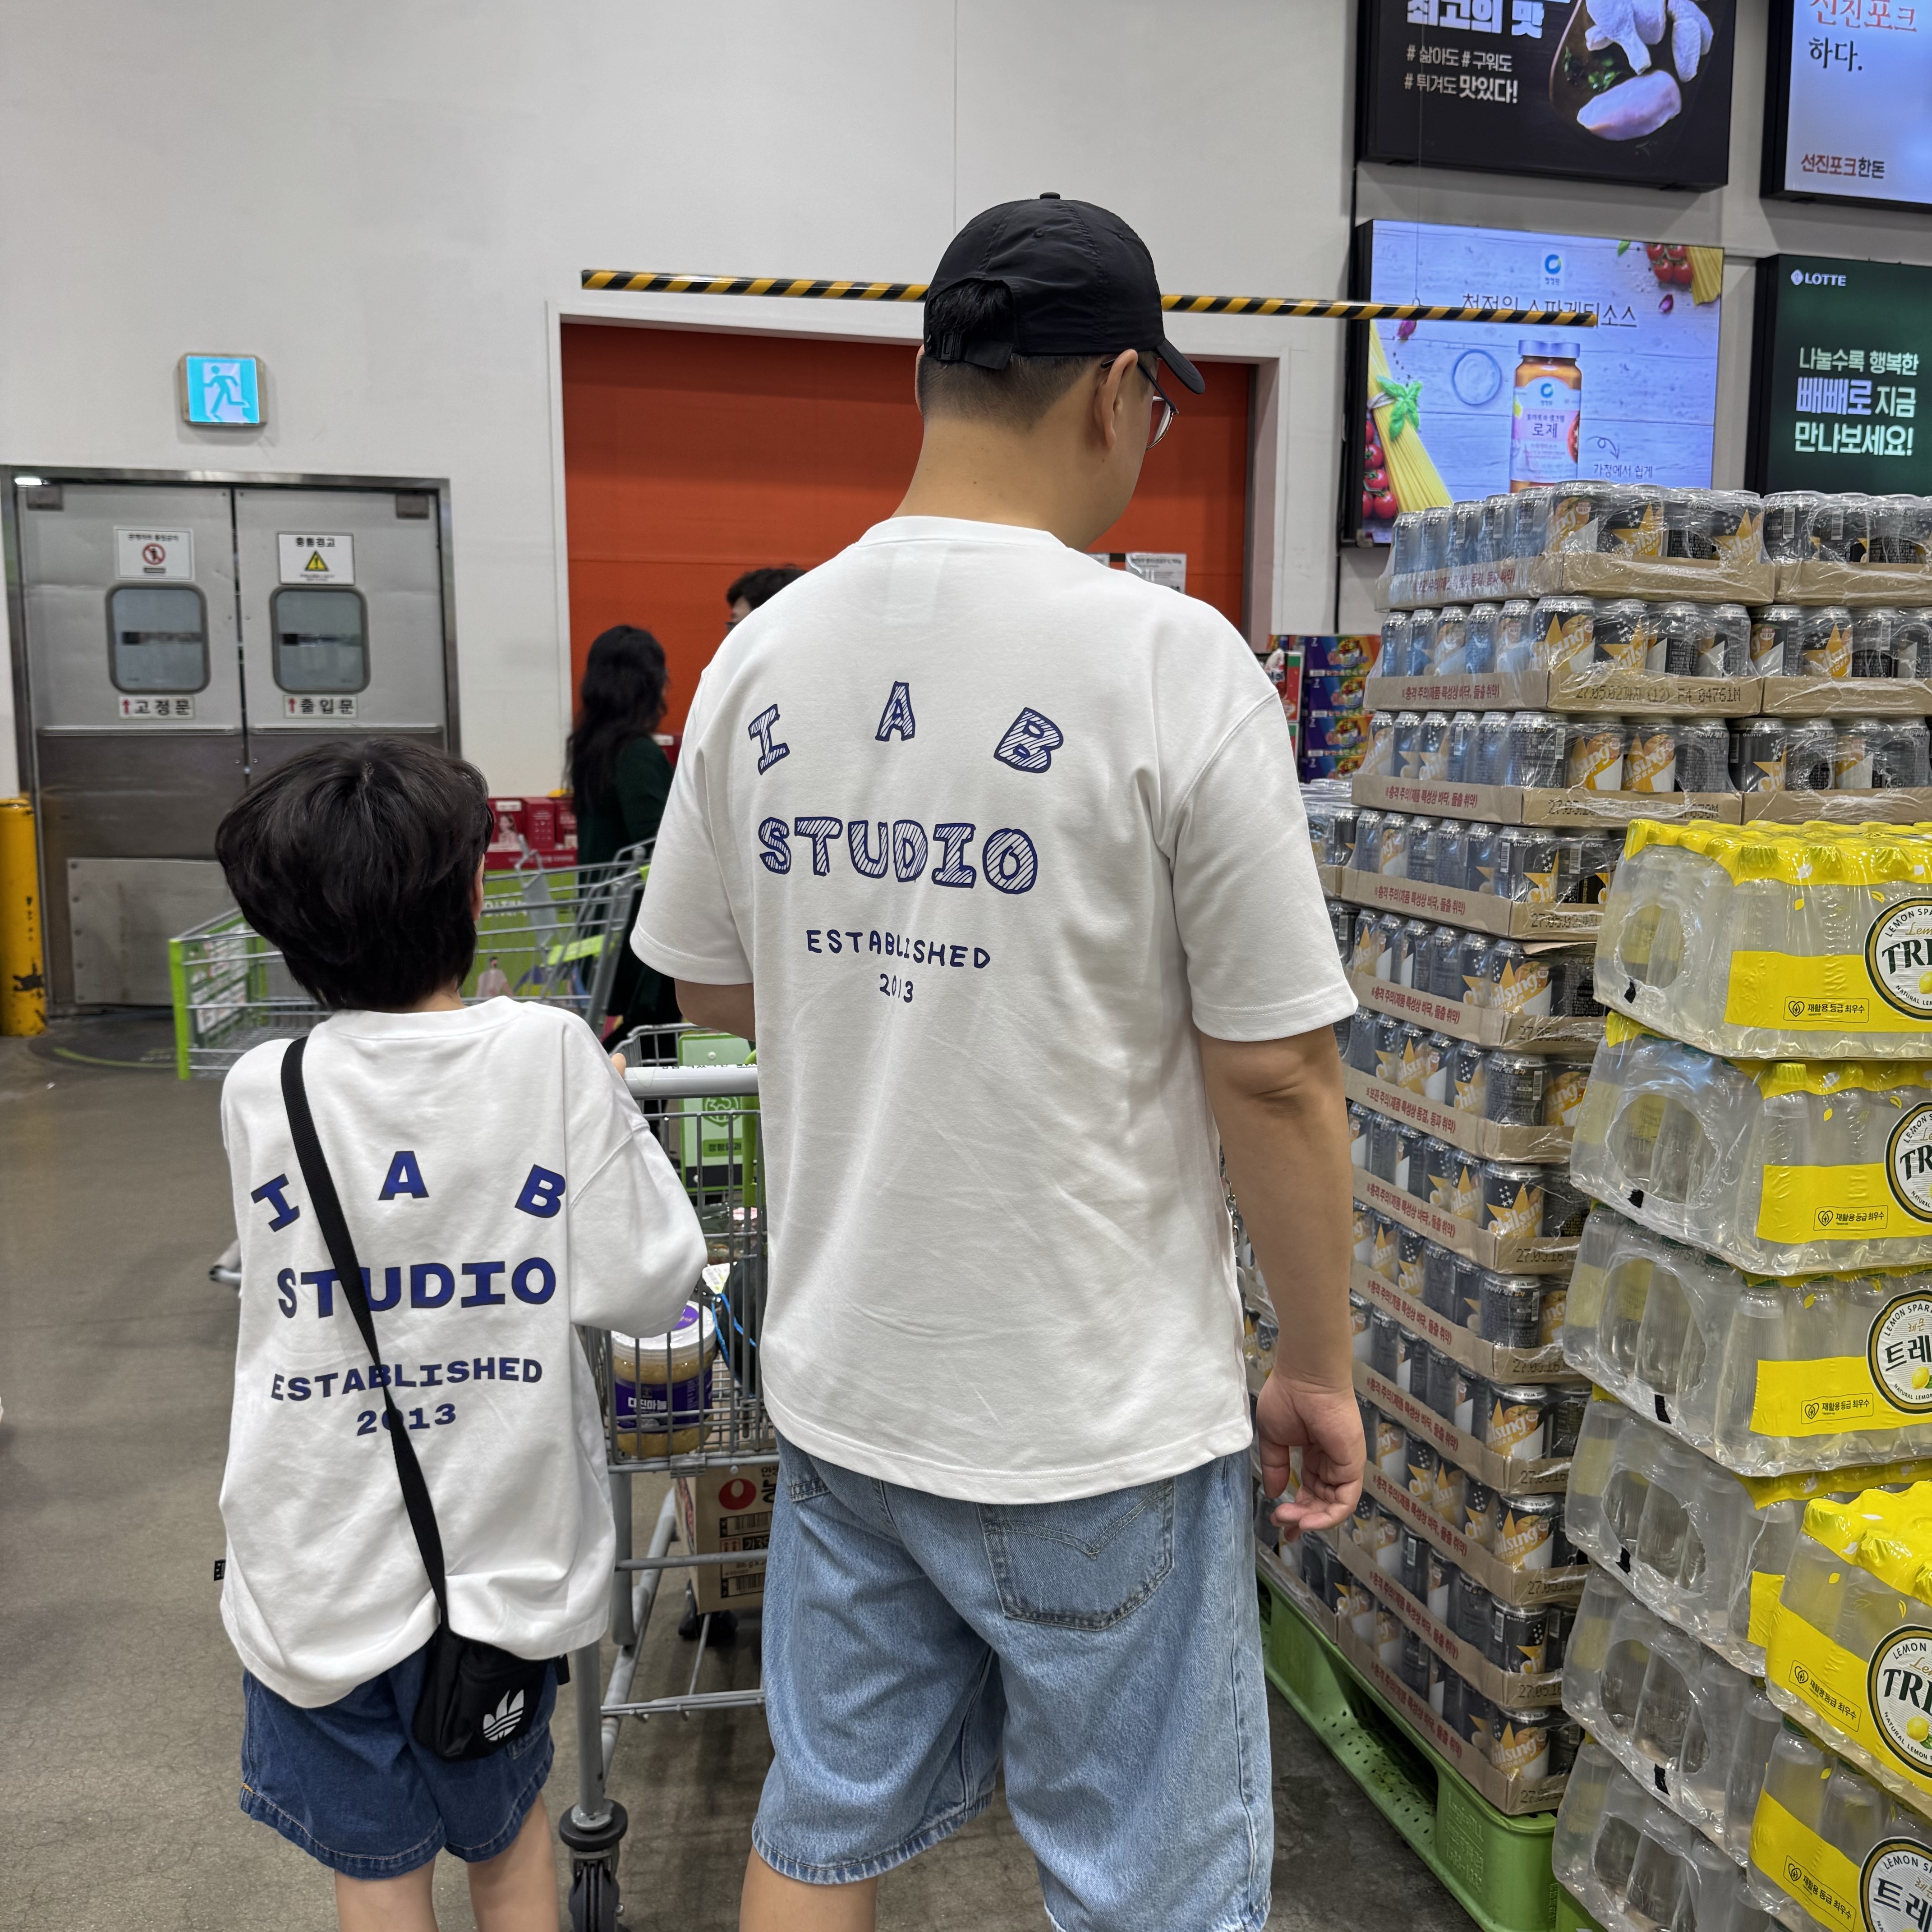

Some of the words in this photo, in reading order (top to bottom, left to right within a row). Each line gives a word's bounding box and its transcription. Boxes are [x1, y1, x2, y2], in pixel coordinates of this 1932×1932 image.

[1512, 1, 1544, 38] 맛
[1808, 37, 1863, 72] 하다.
[1805, 272, 1847, 286] LOTTE
[1799, 347, 1864, 372] 나눌수록
[1869, 350, 1919, 376] 행복한
[1796, 377, 1872, 415] 빼빼로
[1875, 385, 1916, 418] 지금
[1532, 422, 1558, 438] 로제
[1795, 421, 1914, 456] 만나보세요!
[135, 699, 190, 715] 고정문
[300, 698, 354, 715] 출입문
[759, 817, 1038, 895] STUDIO
[1885, 910, 1915, 938] LEMON
[806, 929, 990, 969] ESTABLISHED
[879, 973, 913, 1003] 2013
[1895, 984, 1920, 1004] NATURAL
[1808, 1004, 1828, 1013] 재활용
[1830, 1004, 1844, 1013] 등급
[1845, 1004, 1865, 1014] 최우수
[1903, 1115, 1927, 1144] LEMON
[1910, 1190, 1931, 1208] NATURAL
[1855, 1213, 1867, 1221] 등급
[277, 1257, 556, 1319] STUDIO
[1884, 1308, 1906, 1336] LEMON
[1907, 1318, 1926, 1333] 레몬
[271, 1357, 543, 1401] ESTABLISHED
[1894, 1383, 1913, 1400] NATURAL
[1840, 1400, 1852, 1410] 등급
[1892, 1642, 1927, 1660] LEMON
[1884, 1712, 1905, 1744] NATURAL
[1907, 1743, 1928, 1760] LEMON
[1883, 1854, 1919, 1870] LEMON
